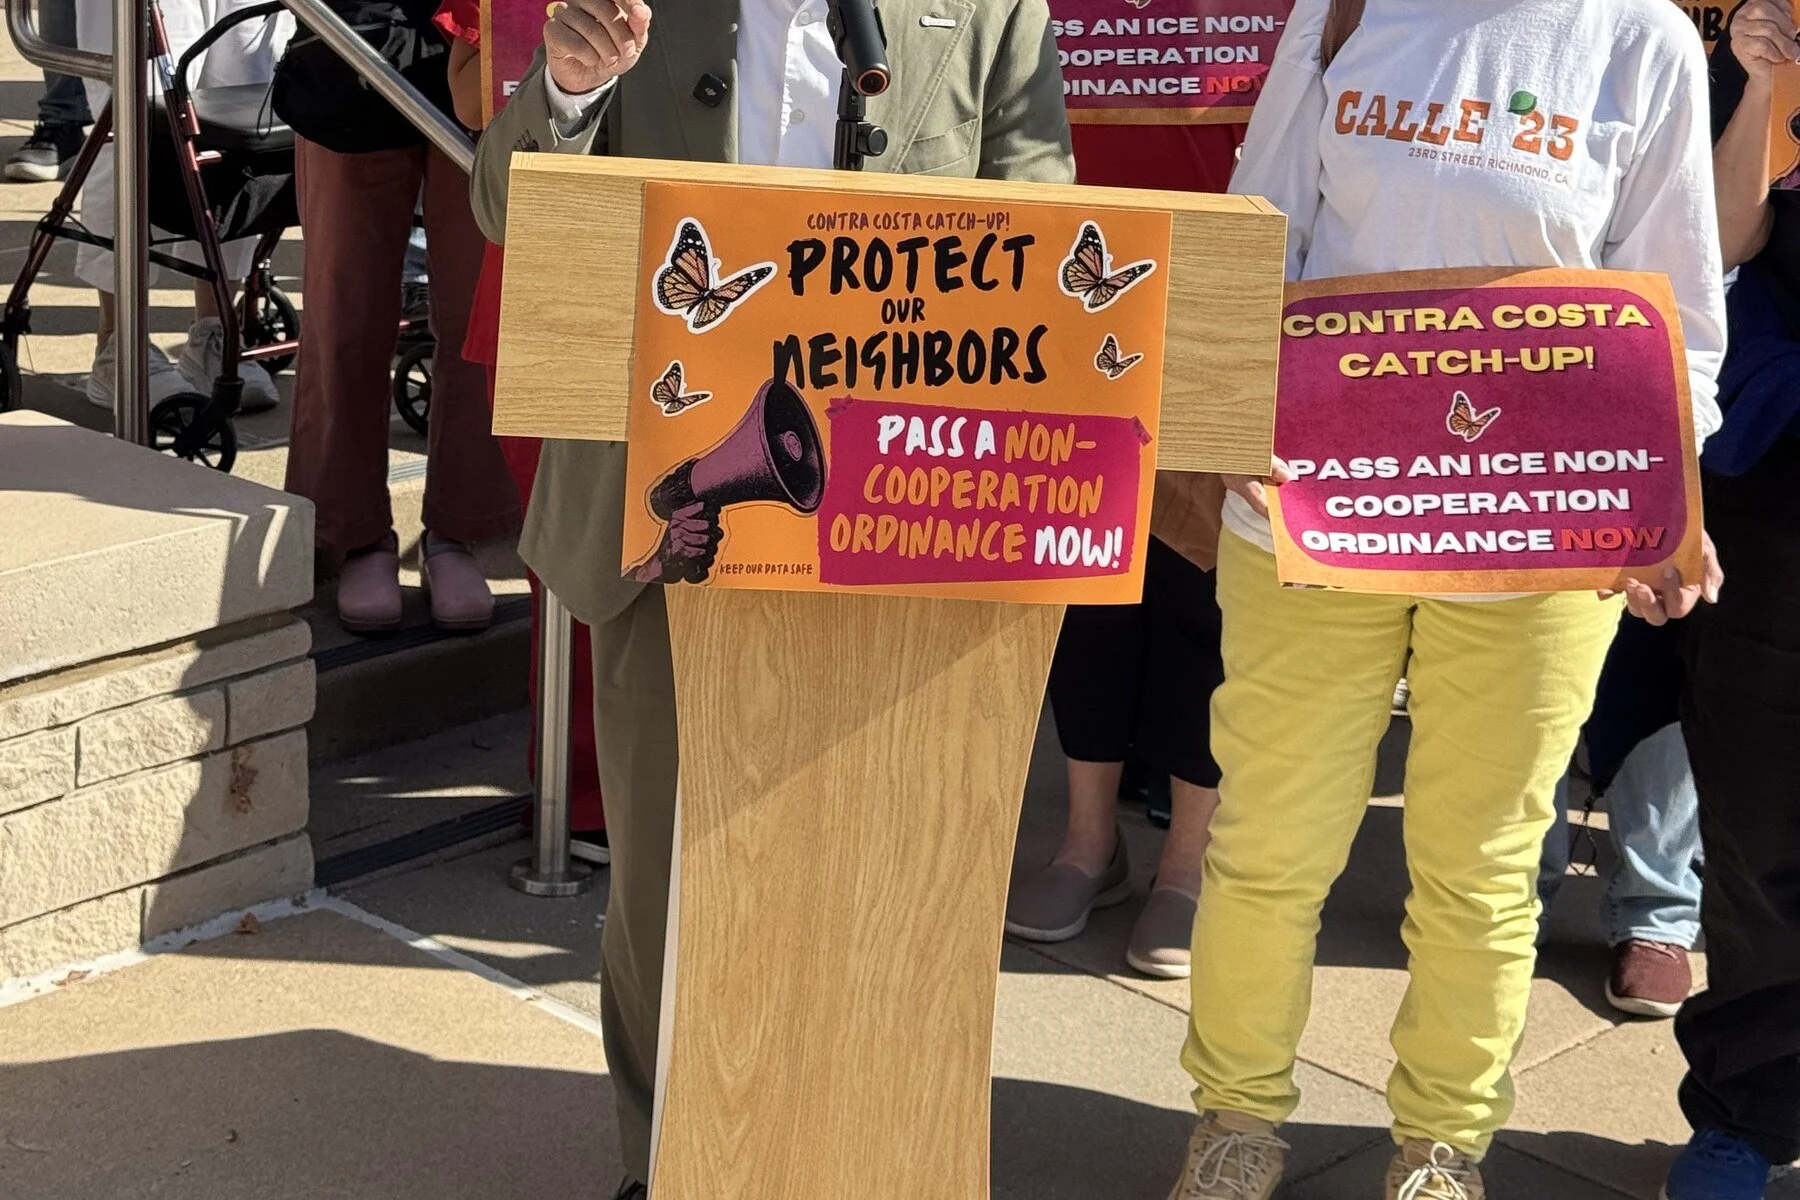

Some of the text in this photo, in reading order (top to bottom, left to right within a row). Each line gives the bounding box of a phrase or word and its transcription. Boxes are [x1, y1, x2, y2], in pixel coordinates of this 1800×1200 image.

[1052, 15, 1285, 37] SS AN ICE NON-
[1058, 45, 1259, 67] OOPERATION
[1334, 90, 1579, 161] CALLE 23
[1408, 147, 1569, 185] 23RD STREET, RICHMOND, CA
[807, 211, 1010, 232] CONTRA COSTA CATCH-UP!
[786, 233, 1036, 296] PROTECT
[881, 297, 926, 325] OUR
[1282, 303, 1653, 338] CONTRA COSTA
[772, 324, 1049, 391] NEIGHBORS
[1338, 345, 1595, 378] CATCH-UP!
[877, 414, 1097, 466] PASS A NON-
[1288, 448, 1664, 481] PASS AN ICE NON-
[863, 463, 1104, 518] COOPERATION
[1325, 488, 1631, 519] COOPERATION
[829, 513, 1124, 569] ORDINANCE NOW!
[1302, 526, 1668, 555] ORDINANCE NOW
[720, 563, 813, 575] KEEP OUR DATA SAFE
